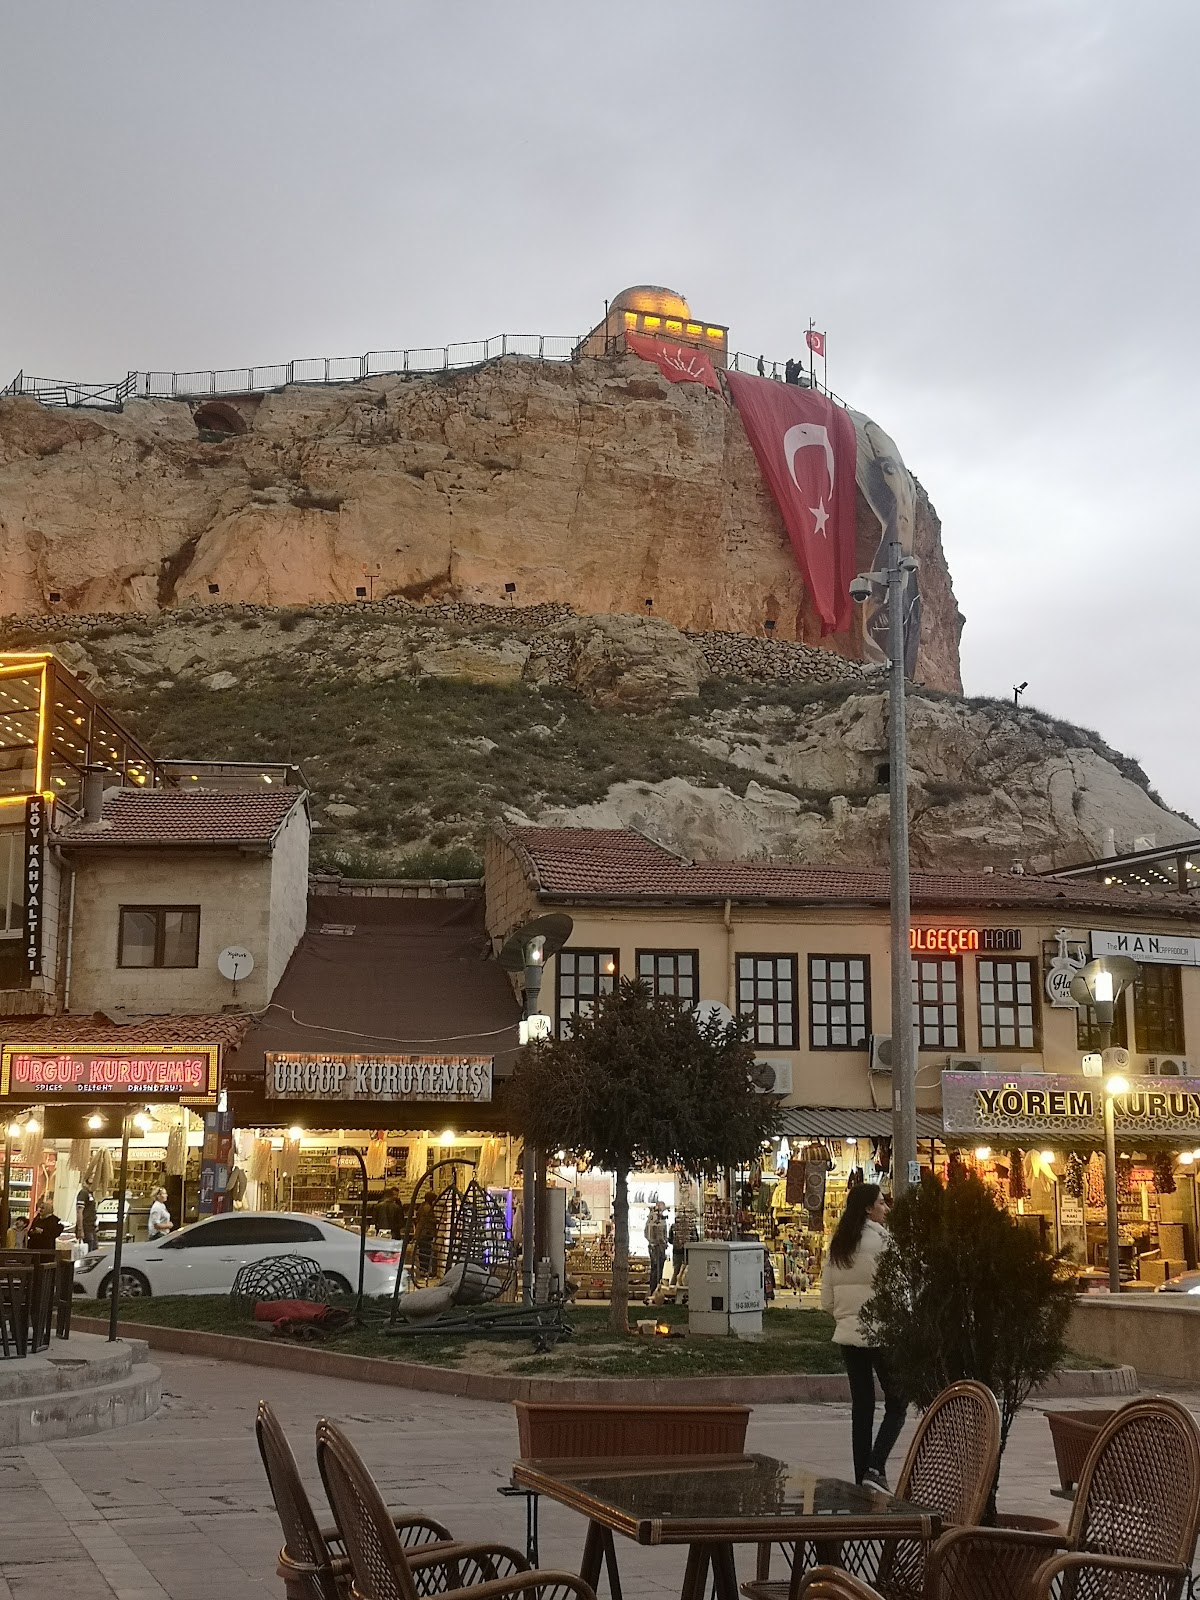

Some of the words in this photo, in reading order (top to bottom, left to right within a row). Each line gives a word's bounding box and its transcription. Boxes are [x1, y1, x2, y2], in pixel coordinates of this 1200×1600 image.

[30, 802, 40, 838] KÖY
[27, 844, 40, 972] KAHVALTISI
[1107, 942, 1118, 951] The
[1053, 973, 1072, 990] Ha
[15, 1055, 85, 1083] ÜRGÜP
[90, 1058, 203, 1087] KURUYEMİŞ
[274, 1055, 347, 1093] ÜRGÜP
[354, 1058, 484, 1097] KURUYEMİŞ
[35, 1084, 63, 1092] SPICES
[979, 1082, 1093, 1117] YÖREM
